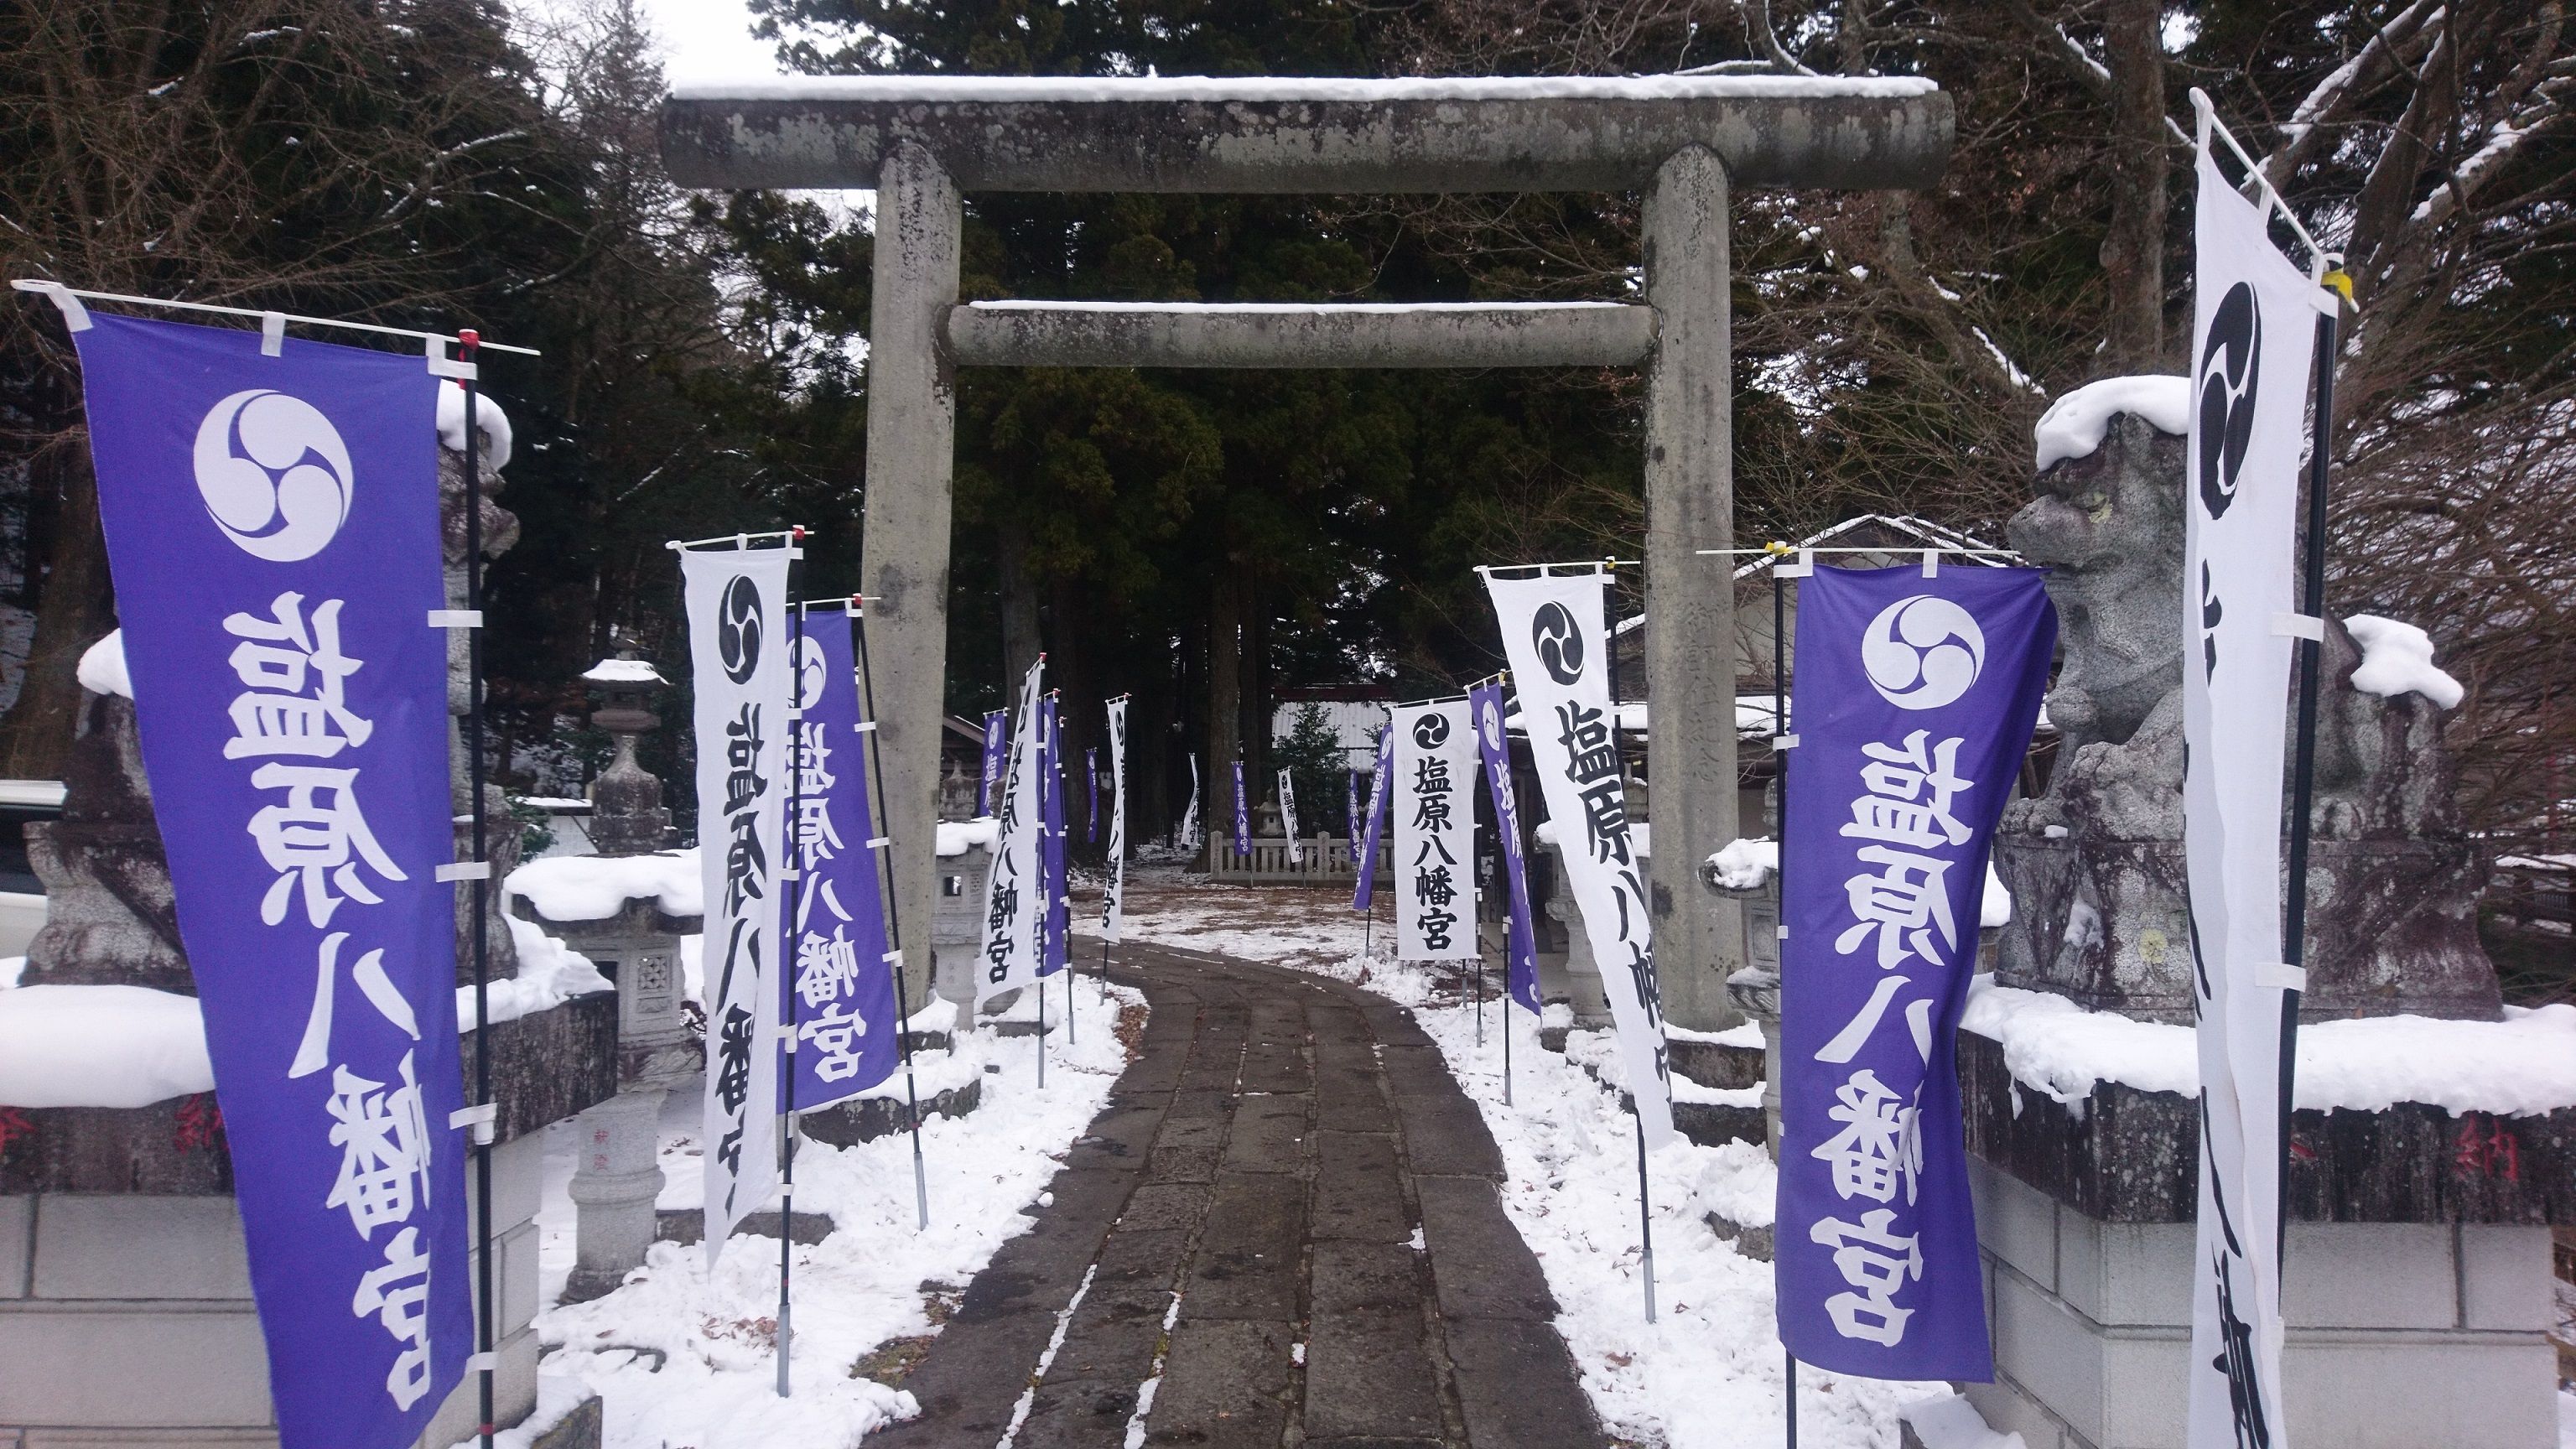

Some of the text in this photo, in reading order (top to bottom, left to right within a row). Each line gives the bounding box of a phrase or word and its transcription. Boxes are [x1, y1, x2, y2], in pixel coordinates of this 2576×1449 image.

[1412, 756, 1457, 951] 塩原八幡宮
